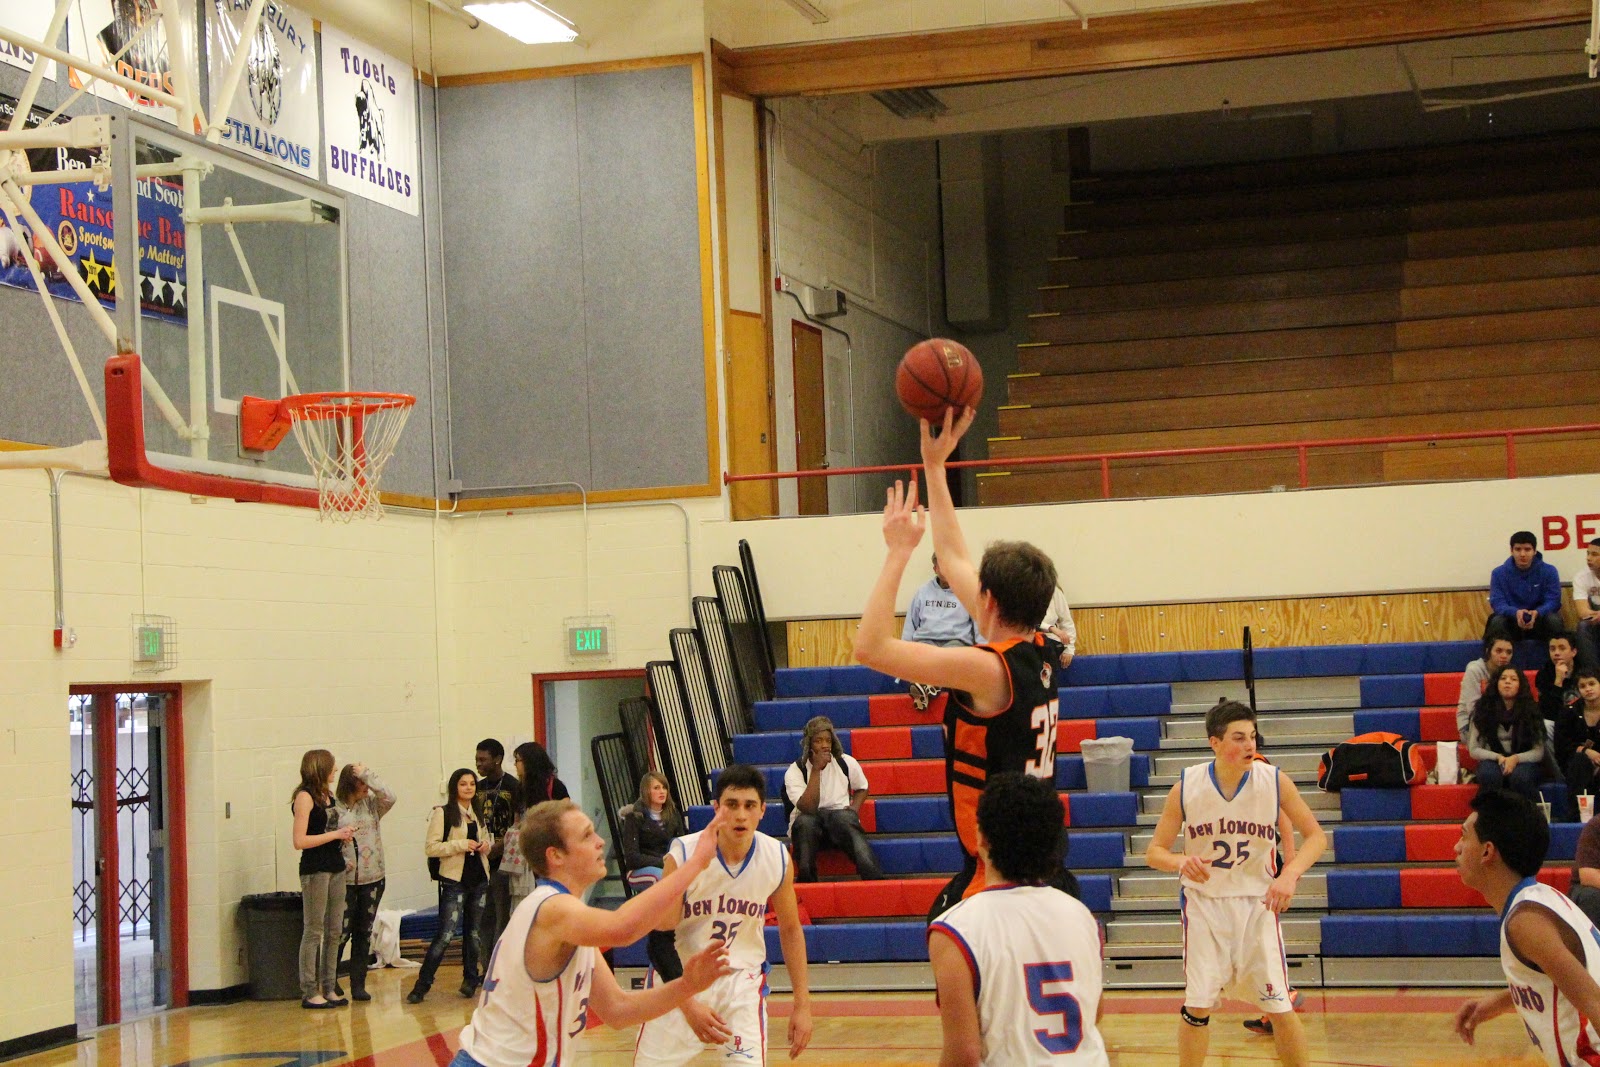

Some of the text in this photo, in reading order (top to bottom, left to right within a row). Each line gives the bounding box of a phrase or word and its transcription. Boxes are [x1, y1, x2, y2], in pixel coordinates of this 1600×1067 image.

[340, 47, 396, 95] Tooele
[220, 117, 311, 169] STALLIONS
[331, 145, 411, 197] BUFFALOES
[155, 177, 184, 209] Scot
[158, 216, 186, 250] Ba
[576, 629, 602, 651] EXIT
[1025, 698, 1059, 778] 32
[1211, 840, 1250, 870] 25
[718, 893, 765, 919] LOMON
[1023, 960, 1084, 1056] 5
